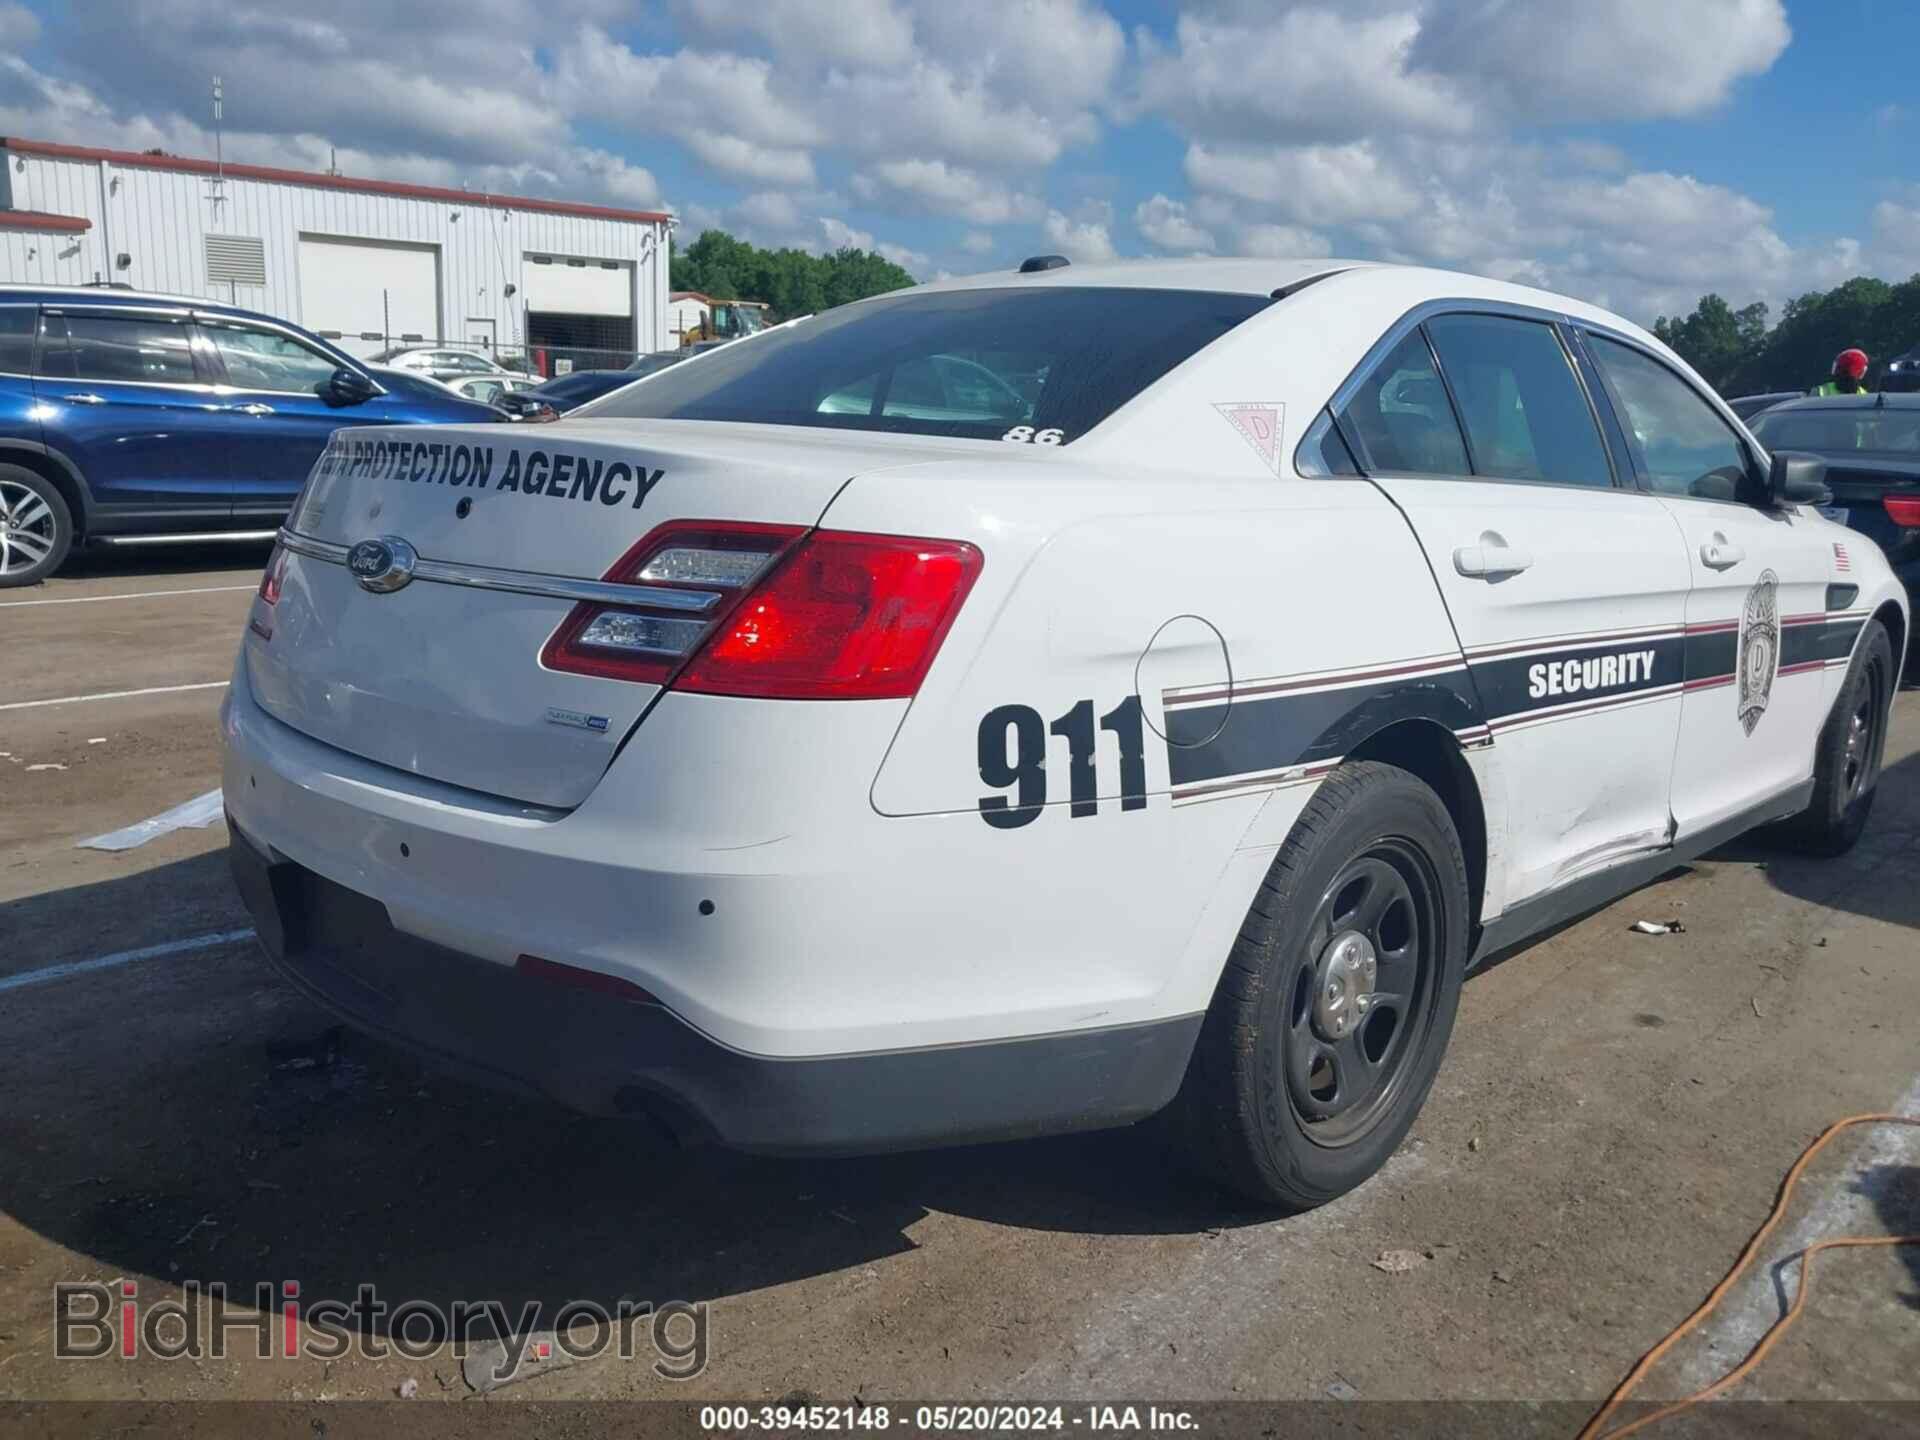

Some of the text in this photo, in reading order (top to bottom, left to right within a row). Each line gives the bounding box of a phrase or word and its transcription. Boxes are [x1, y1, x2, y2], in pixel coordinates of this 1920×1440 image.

[1002, 425, 1064, 446] 86
[349, 440, 493, 488] PROTECTION
[496, 449, 664, 509] AGENCY
[352, 544, 383, 571] Ford
[1528, 650, 1655, 698] SECURITY
[977, 694, 1147, 829] 911
